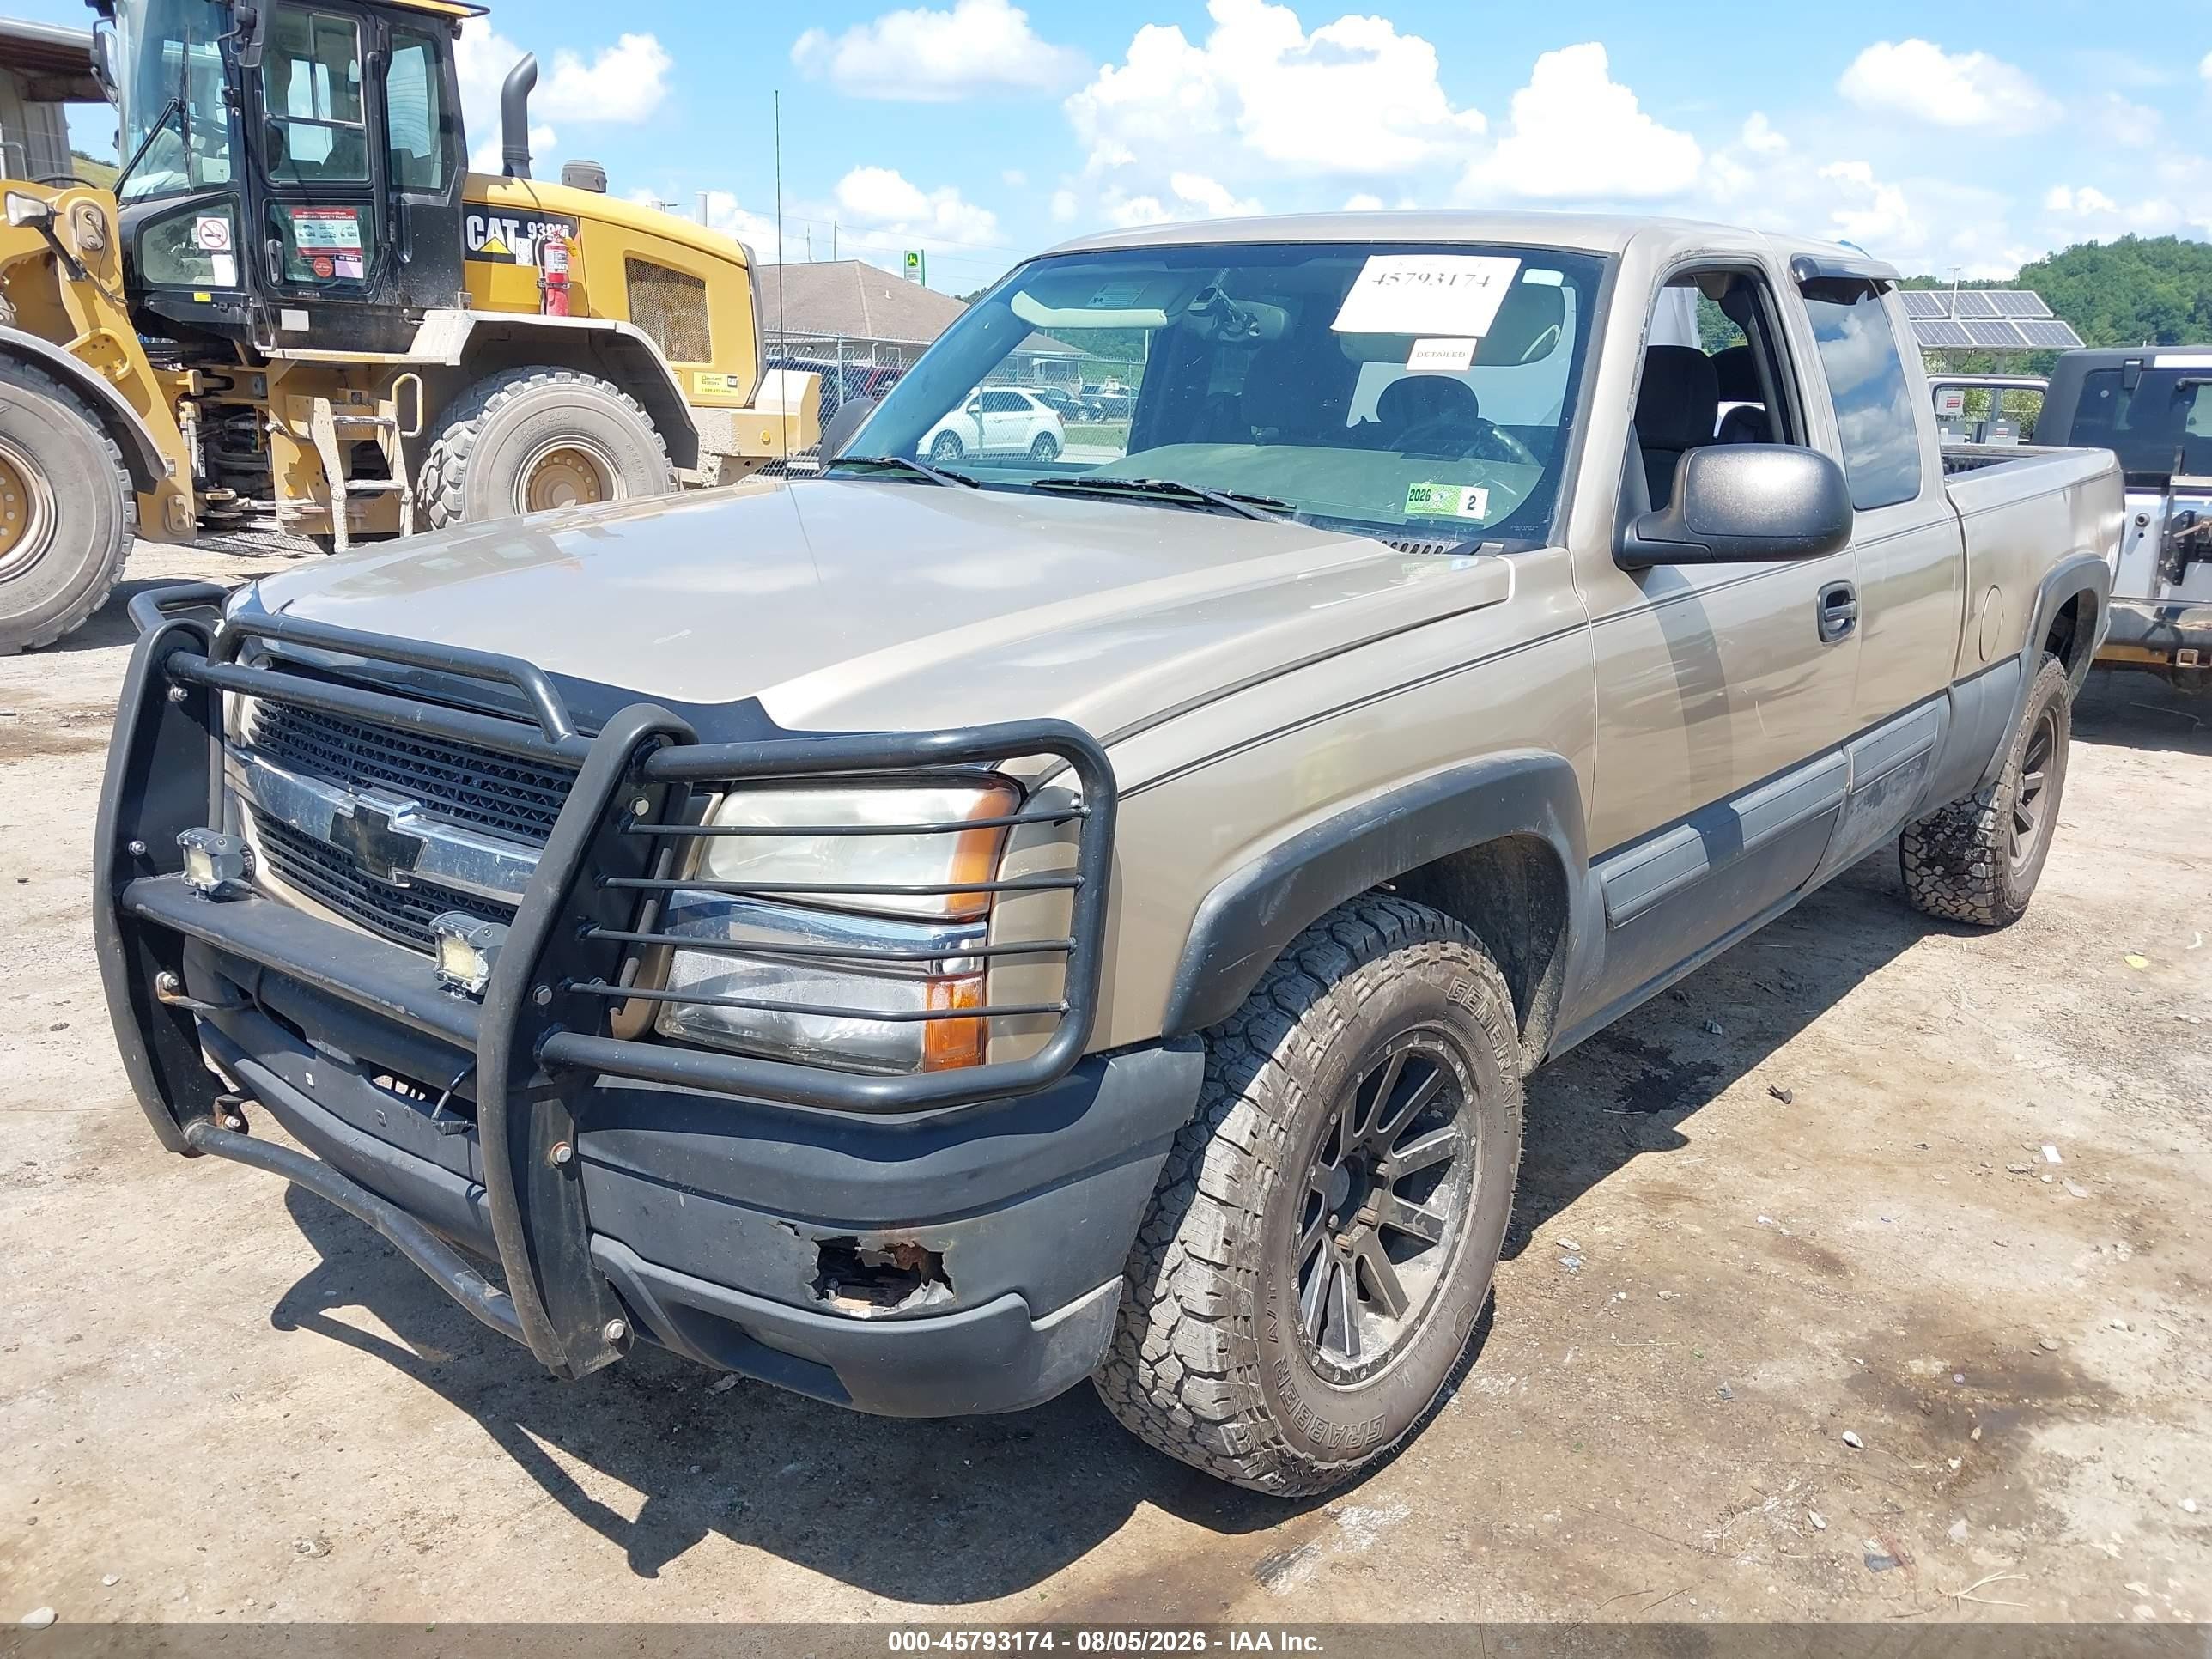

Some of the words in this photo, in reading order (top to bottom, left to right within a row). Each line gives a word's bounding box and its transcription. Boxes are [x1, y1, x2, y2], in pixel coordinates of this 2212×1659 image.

[466, 215, 520, 255] CAT
[1372, 272, 1491, 288] 45793174
[1416, 350, 1467, 359] DETAILED
[1408, 489, 1431, 502] 2026
[1467, 495, 1477, 511] 2
[1447, 976, 1518, 1133] GENERAL
[1273, 1354, 1387, 1449] GRABBER
